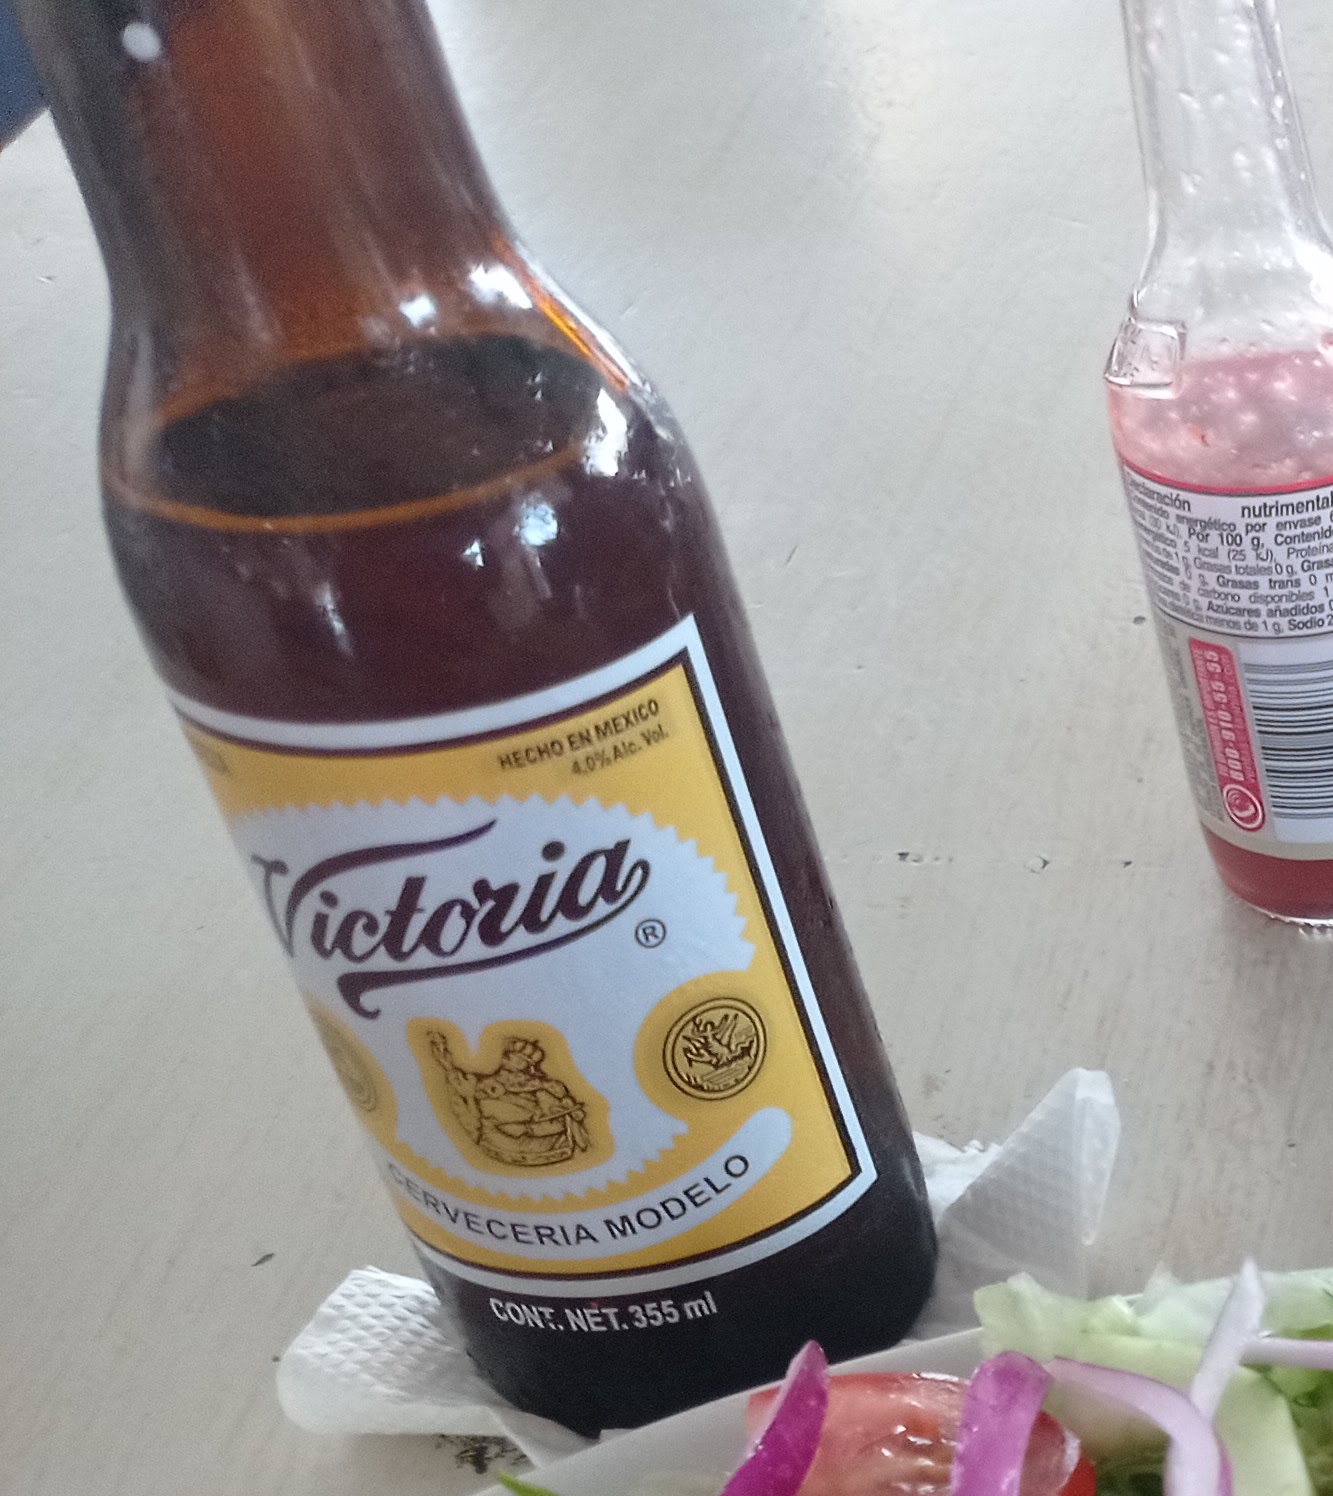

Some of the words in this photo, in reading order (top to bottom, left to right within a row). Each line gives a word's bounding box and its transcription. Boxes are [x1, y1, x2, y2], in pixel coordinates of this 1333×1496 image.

[1241, 491, 1333, 518] nutrimental
[1245, 521, 1267, 536] por
[1276, 515, 1321, 531] envase
[1188, 526, 1210, 543] Por
[1219, 532, 1242, 547] 100
[1228, 549, 1246, 562] (25
[1275, 563, 1283, 575] 0
[1216, 575, 1259, 590] Grasas
[1269, 578, 1301, 590] trans
[1309, 574, 1317, 586] 0
[1249, 590, 1315, 606] disponibles
[1207, 600, 1261, 618] Azúcares
[1266, 603, 1325, 618] añadidos
[1288, 616, 1325, 631] Sodio
[499, 740, 564, 770] HECHO
[567, 728, 592, 751] EN
[595, 699, 660, 741] MEXICO
[641, 724, 670, 747] Vol.
[252, 819, 650, 1019] Victoria
[387, 1162, 600, 1247] CERVECERIA
[603, 1154, 750, 1241] MODELO
[489, 1296, 564, 1331] CONT.
[564, 1306, 628, 1333] NET.
[628, 1299, 681, 1330] 355
[683, 1290, 719, 1320] ml
